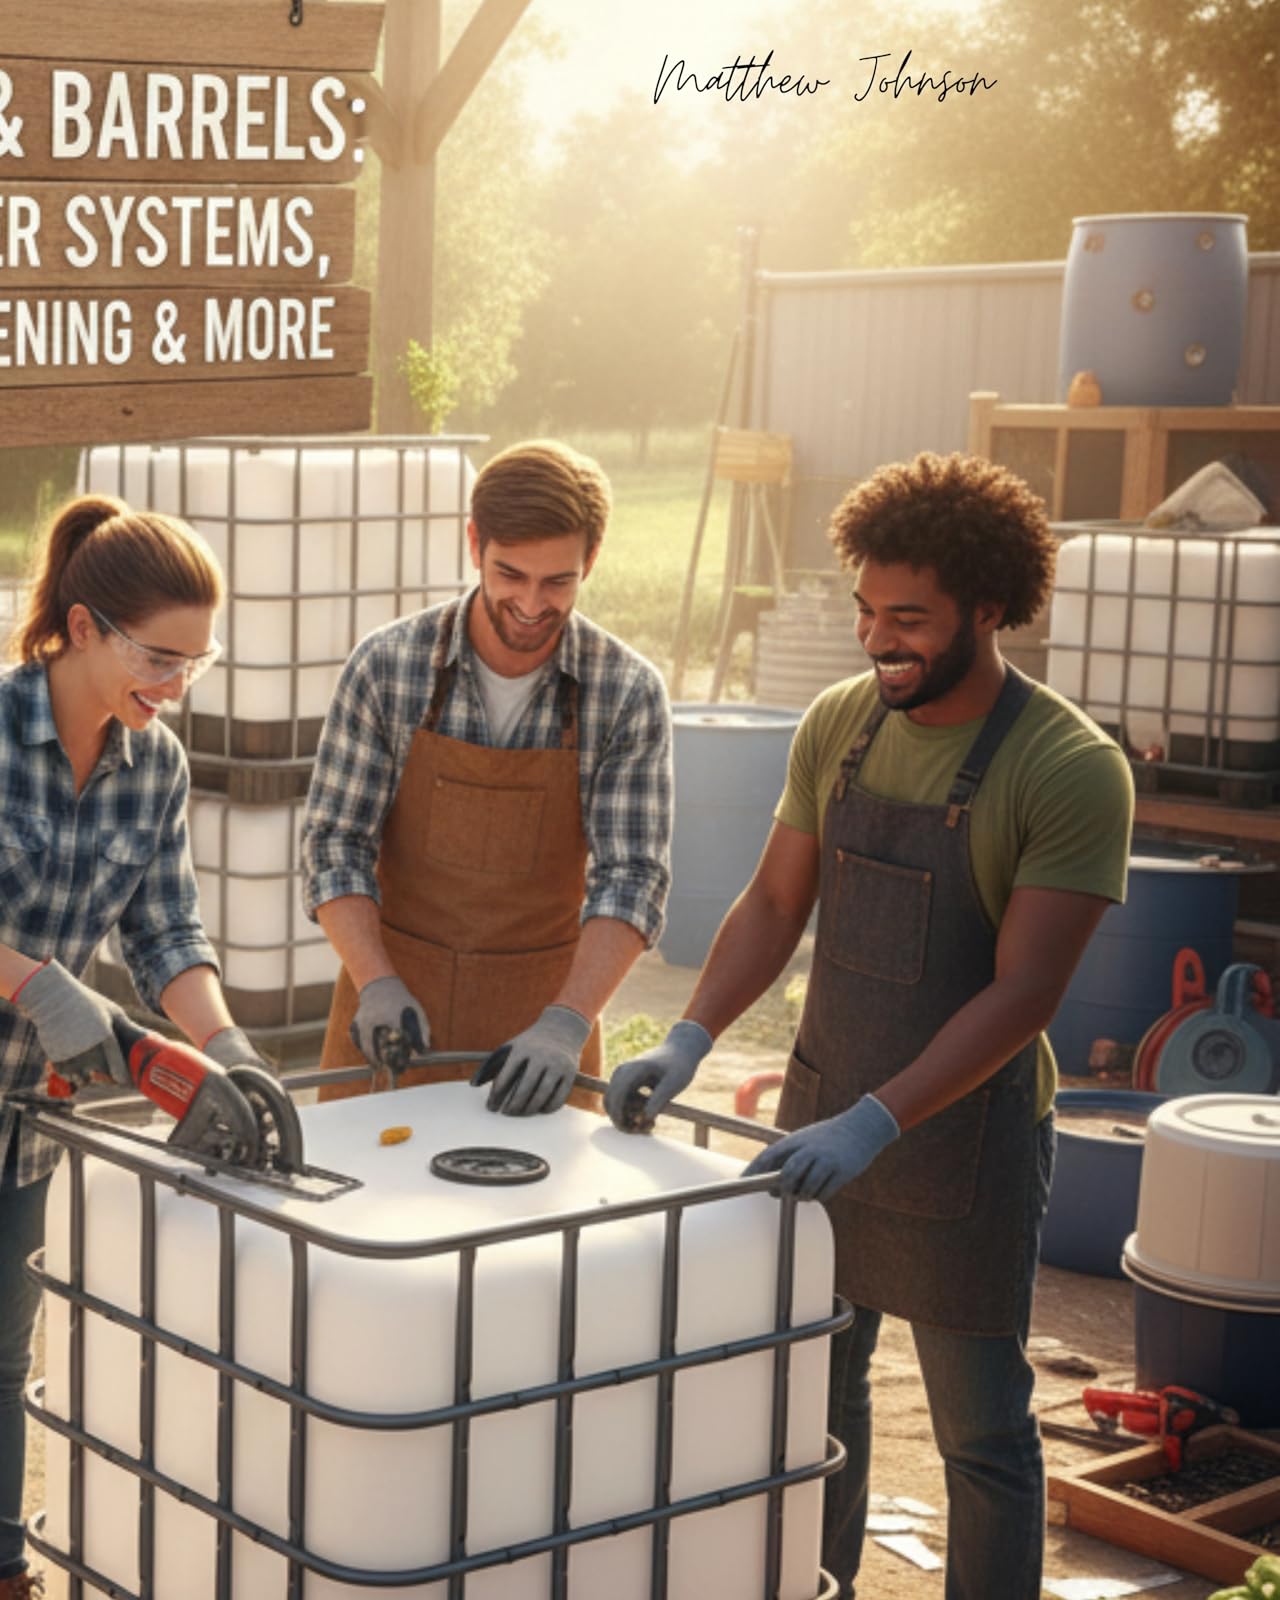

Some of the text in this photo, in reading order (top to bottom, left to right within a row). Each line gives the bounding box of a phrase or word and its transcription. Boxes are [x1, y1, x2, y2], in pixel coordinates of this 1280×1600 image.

[51, 70, 365, 163] BARRELS:
[65, 196, 331, 279] SYSTEMS,
[151, 299, 186, 366] &
[204, 297, 335, 363] MORE
